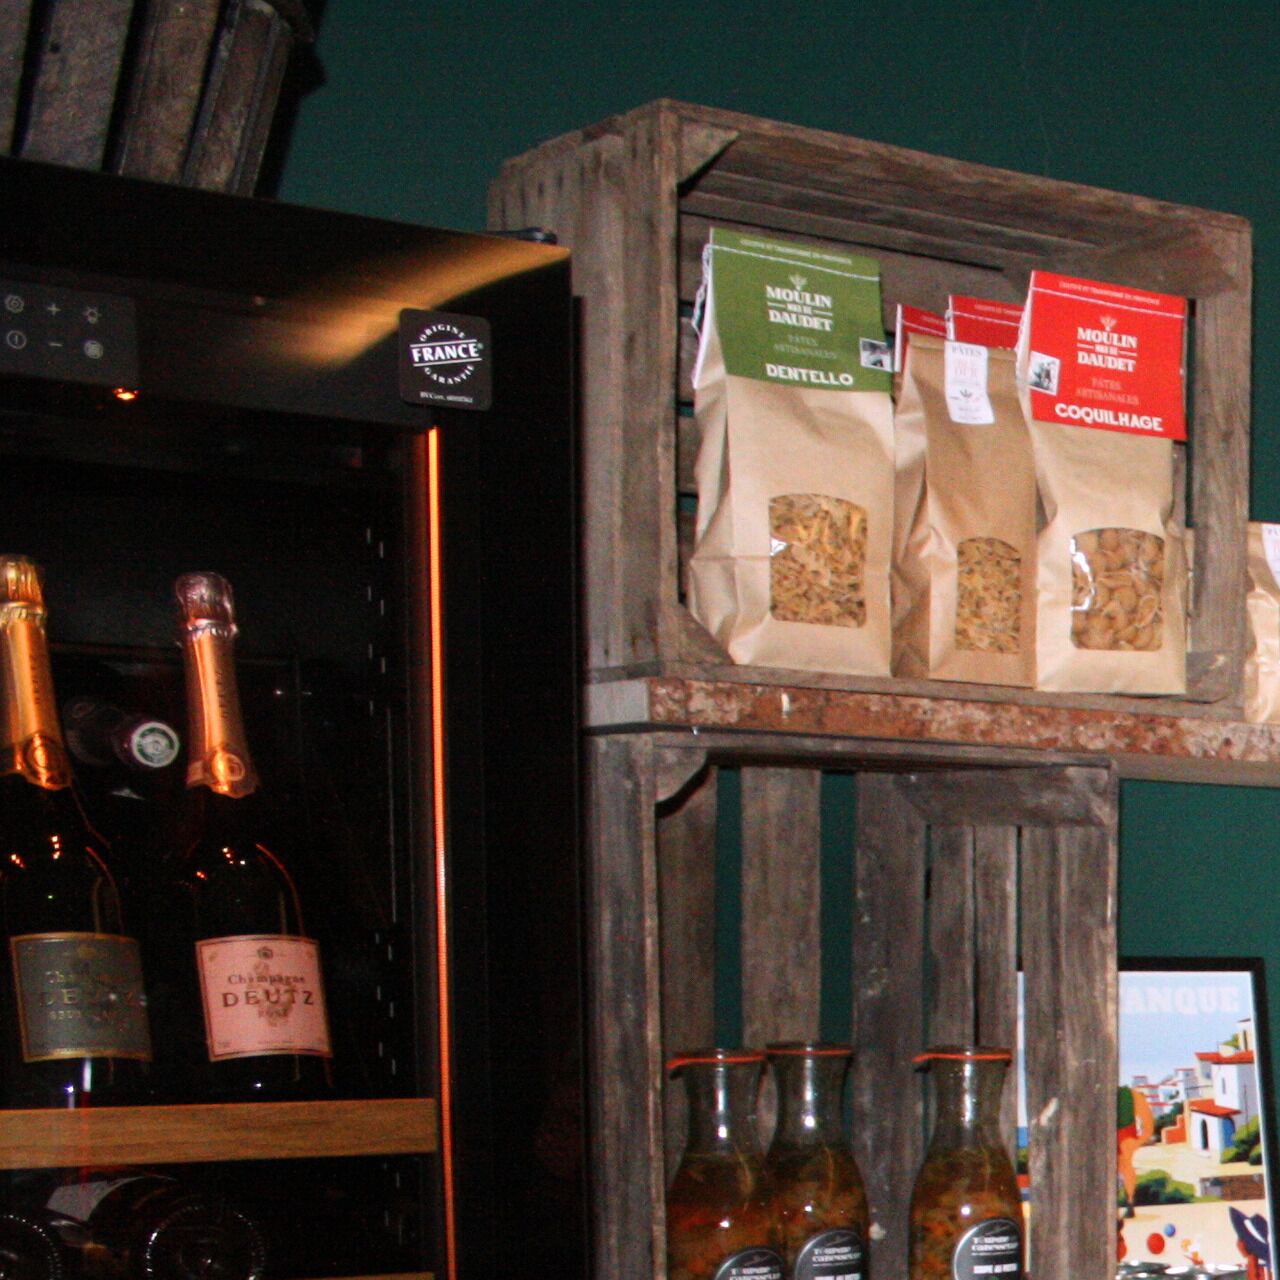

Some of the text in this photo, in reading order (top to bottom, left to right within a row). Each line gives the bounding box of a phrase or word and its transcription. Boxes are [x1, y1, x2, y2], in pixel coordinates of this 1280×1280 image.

[765, 284, 832, 309] MOULIN
[768, 309, 833, 332] DAUDET
[419, 323, 466, 342] ORIGINE
[1076, 327, 1138, 349] MOULIN
[411, 343, 479, 363] FRANCE
[1077, 351, 1137, 373] DAUDET
[424, 364, 474, 385] GARANTIE
[765, 362, 854, 386] DENTELLO
[1054, 403, 1164, 431] COQUILHAGE
[221, 988, 315, 1008] DEUTZ
